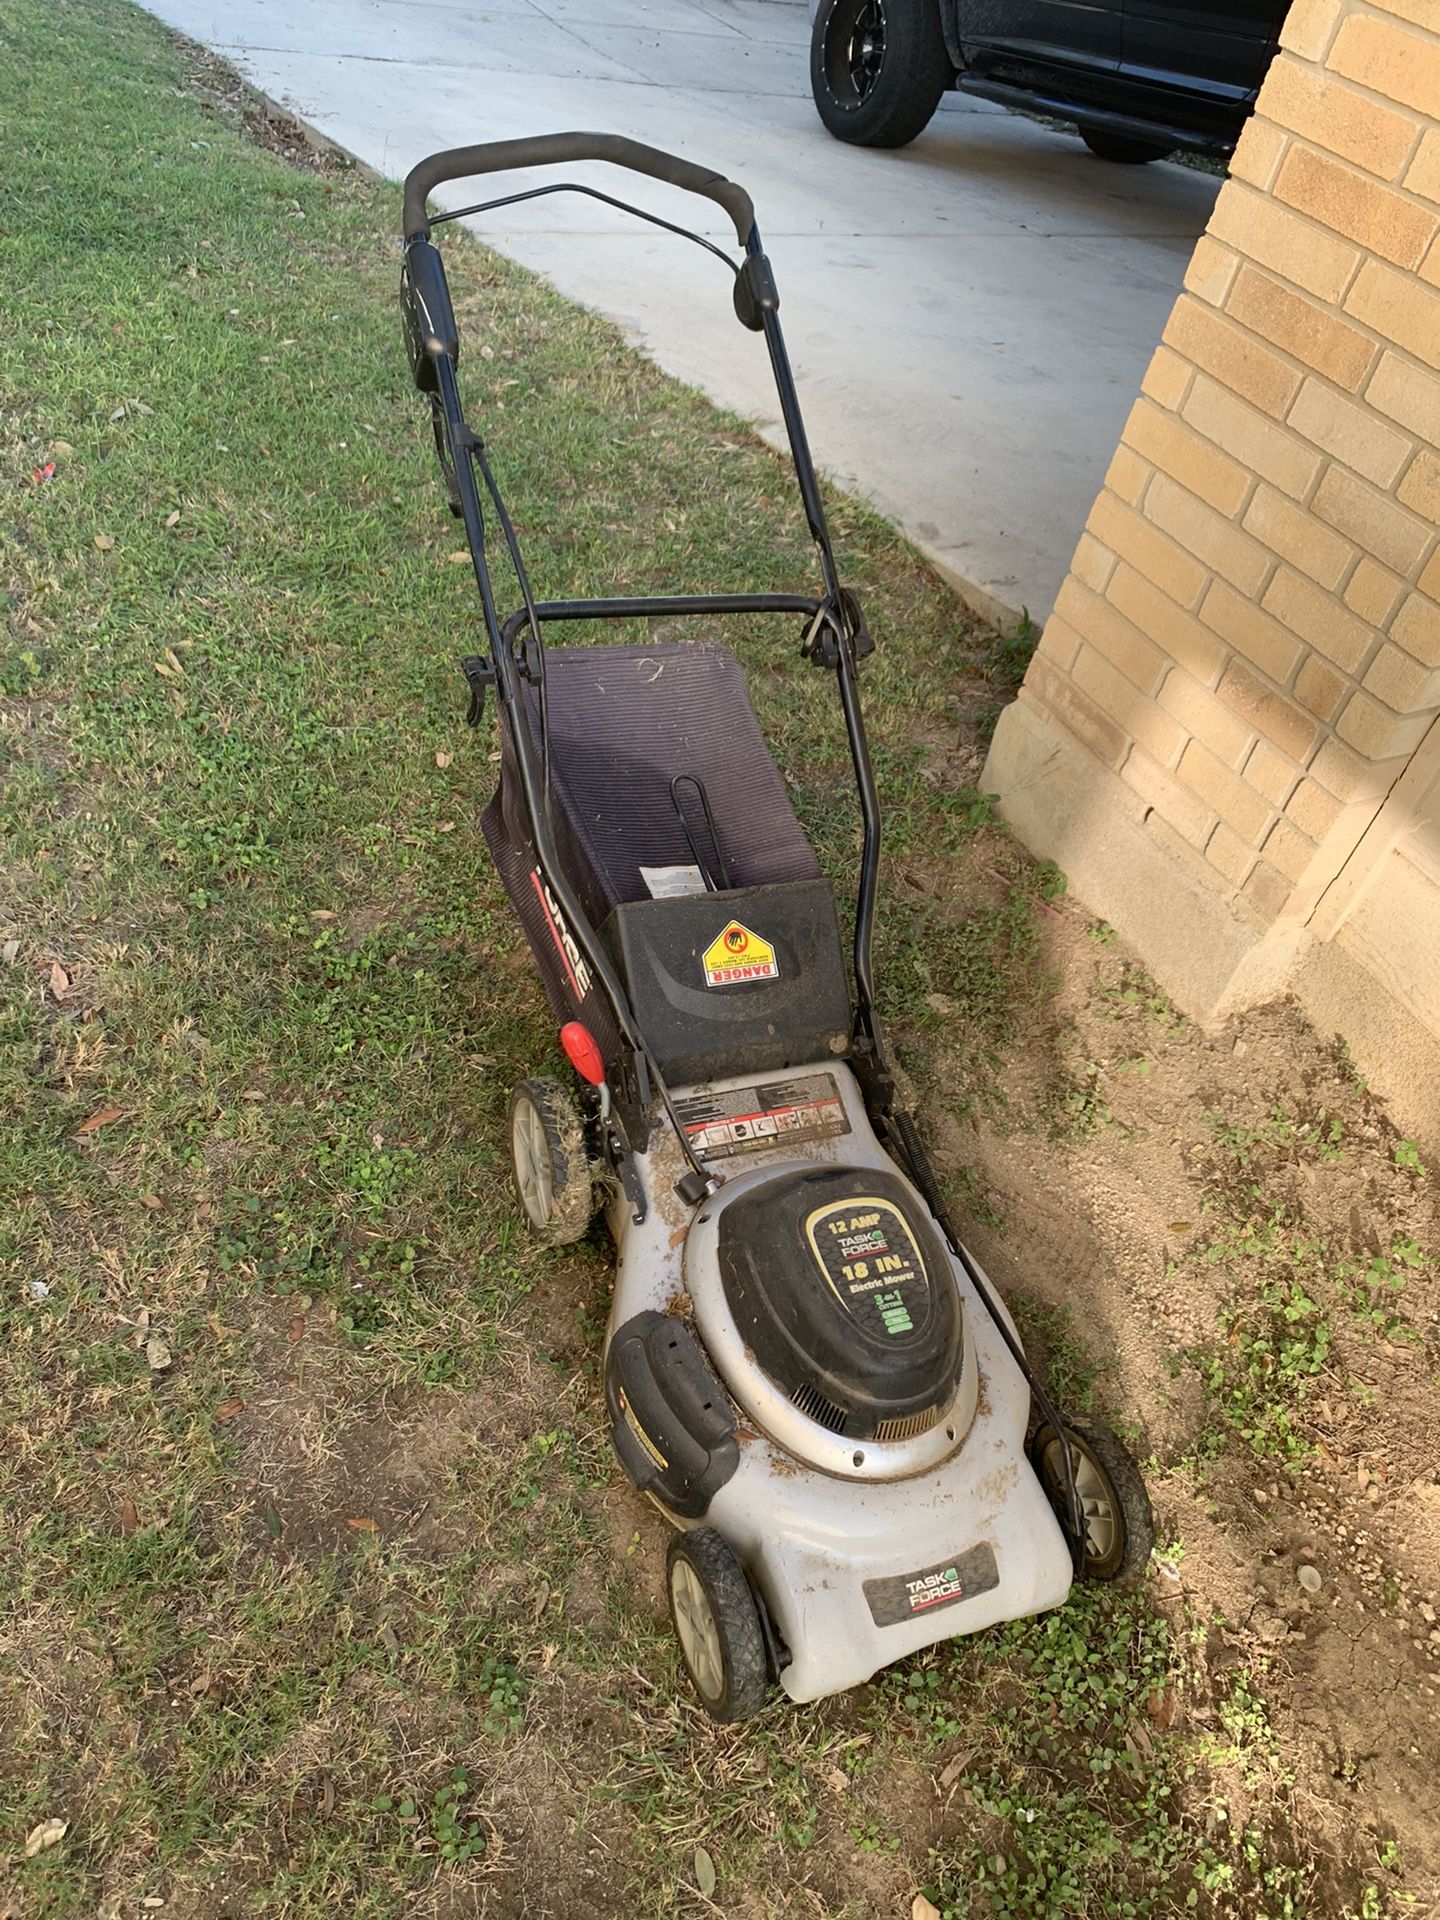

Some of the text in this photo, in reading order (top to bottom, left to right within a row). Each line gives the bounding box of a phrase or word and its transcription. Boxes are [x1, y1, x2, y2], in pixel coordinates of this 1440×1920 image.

[713, 964, 772, 982] DANGER
[828, 1213, 881, 1235] 12 AMP
[838, 1231, 873, 1247] TASK
[841, 1239, 888, 1257] FORCE
[842, 1254, 910, 1281] 18 IN.
[849, 1271, 915, 1294] Electric Mower
[905, 1571, 948, 1593] TASK
[909, 1580, 962, 1607] FORCE
